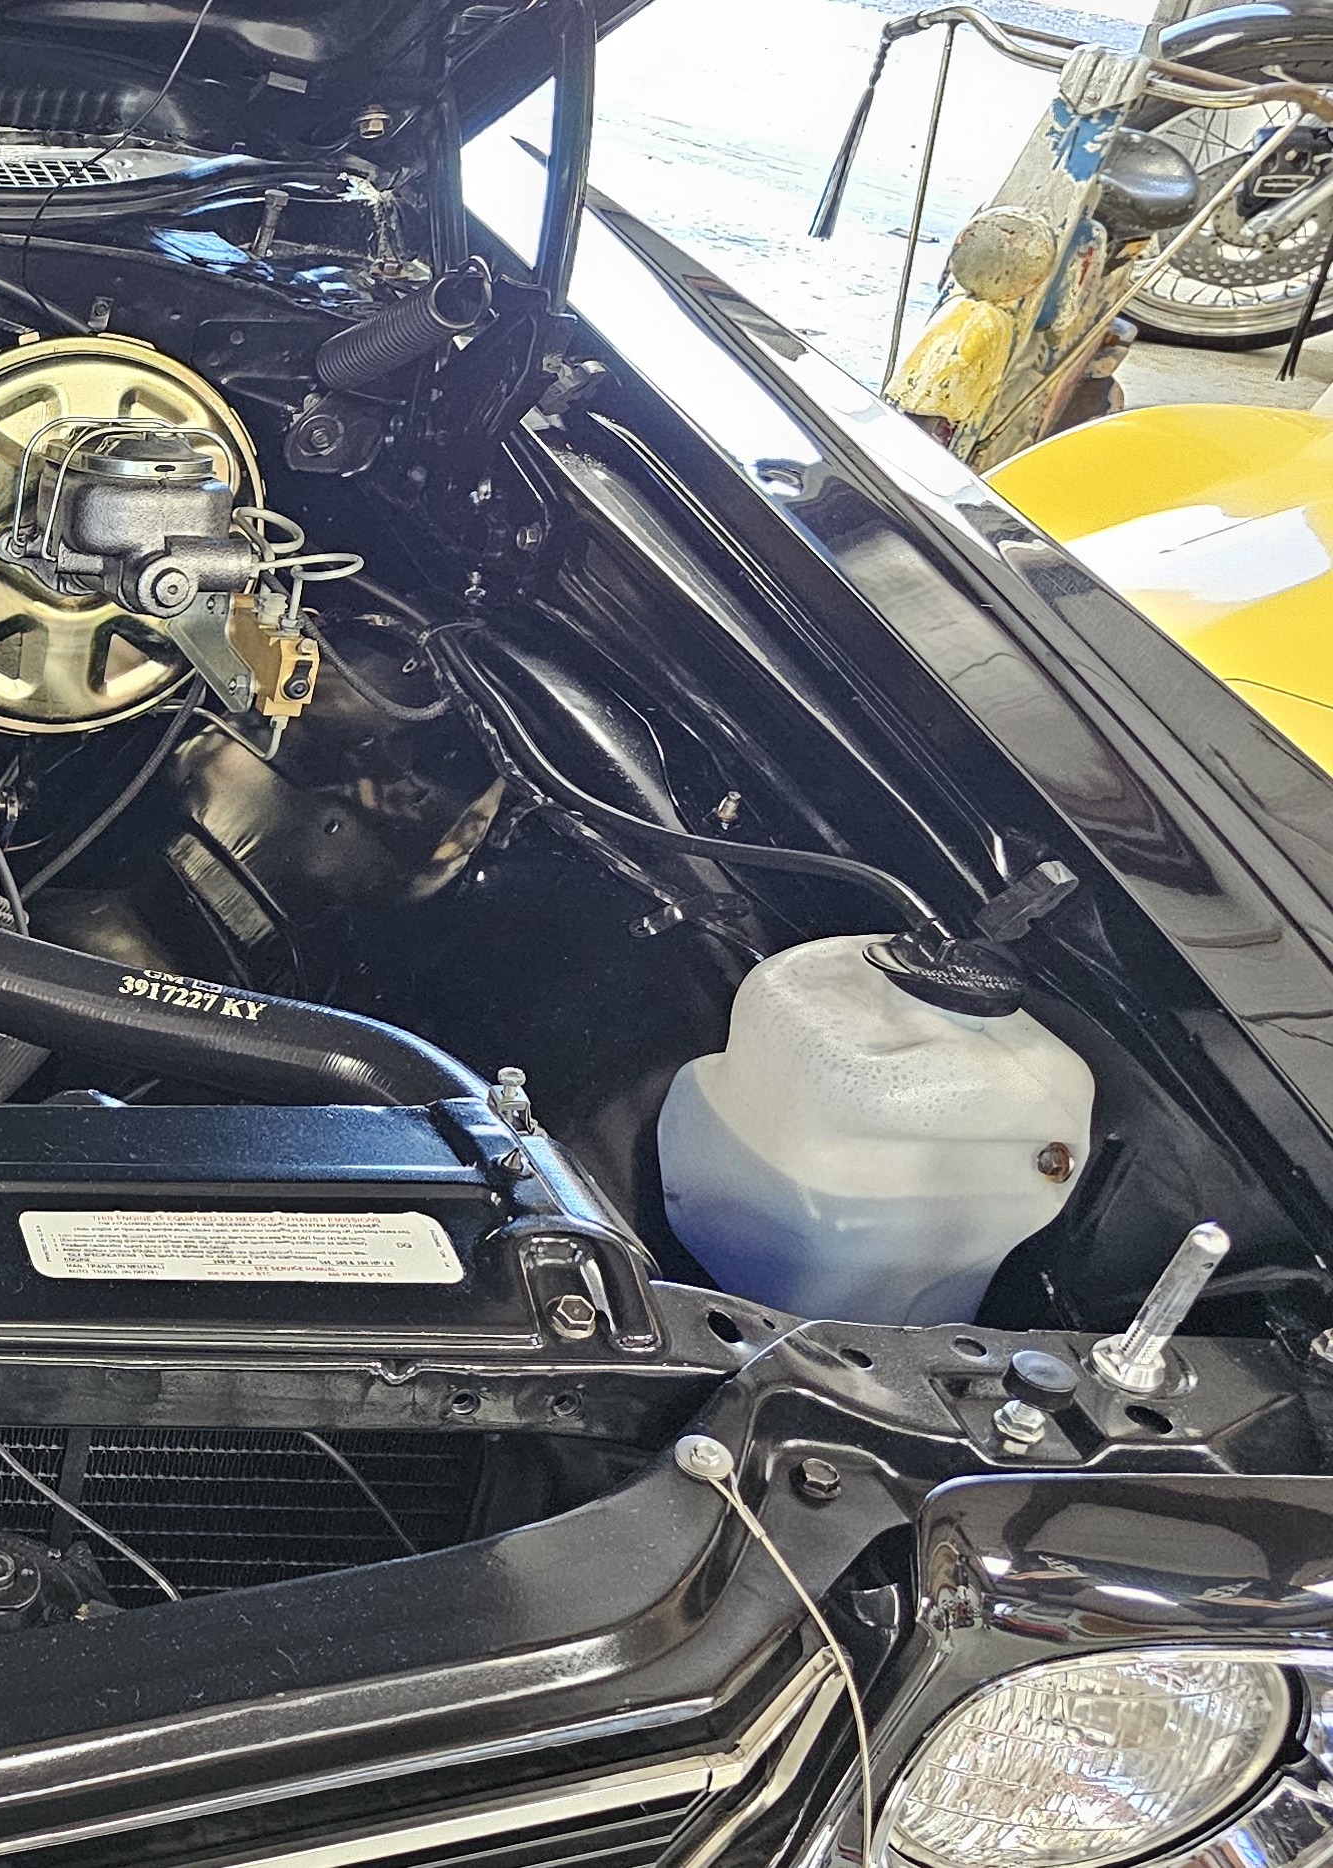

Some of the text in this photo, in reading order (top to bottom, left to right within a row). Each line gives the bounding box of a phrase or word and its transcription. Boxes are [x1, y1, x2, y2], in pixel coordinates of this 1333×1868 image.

[142, 969, 185, 985] GM
[118, 975, 219, 1012] 3917227
[219, 996, 268, 1021] KY
